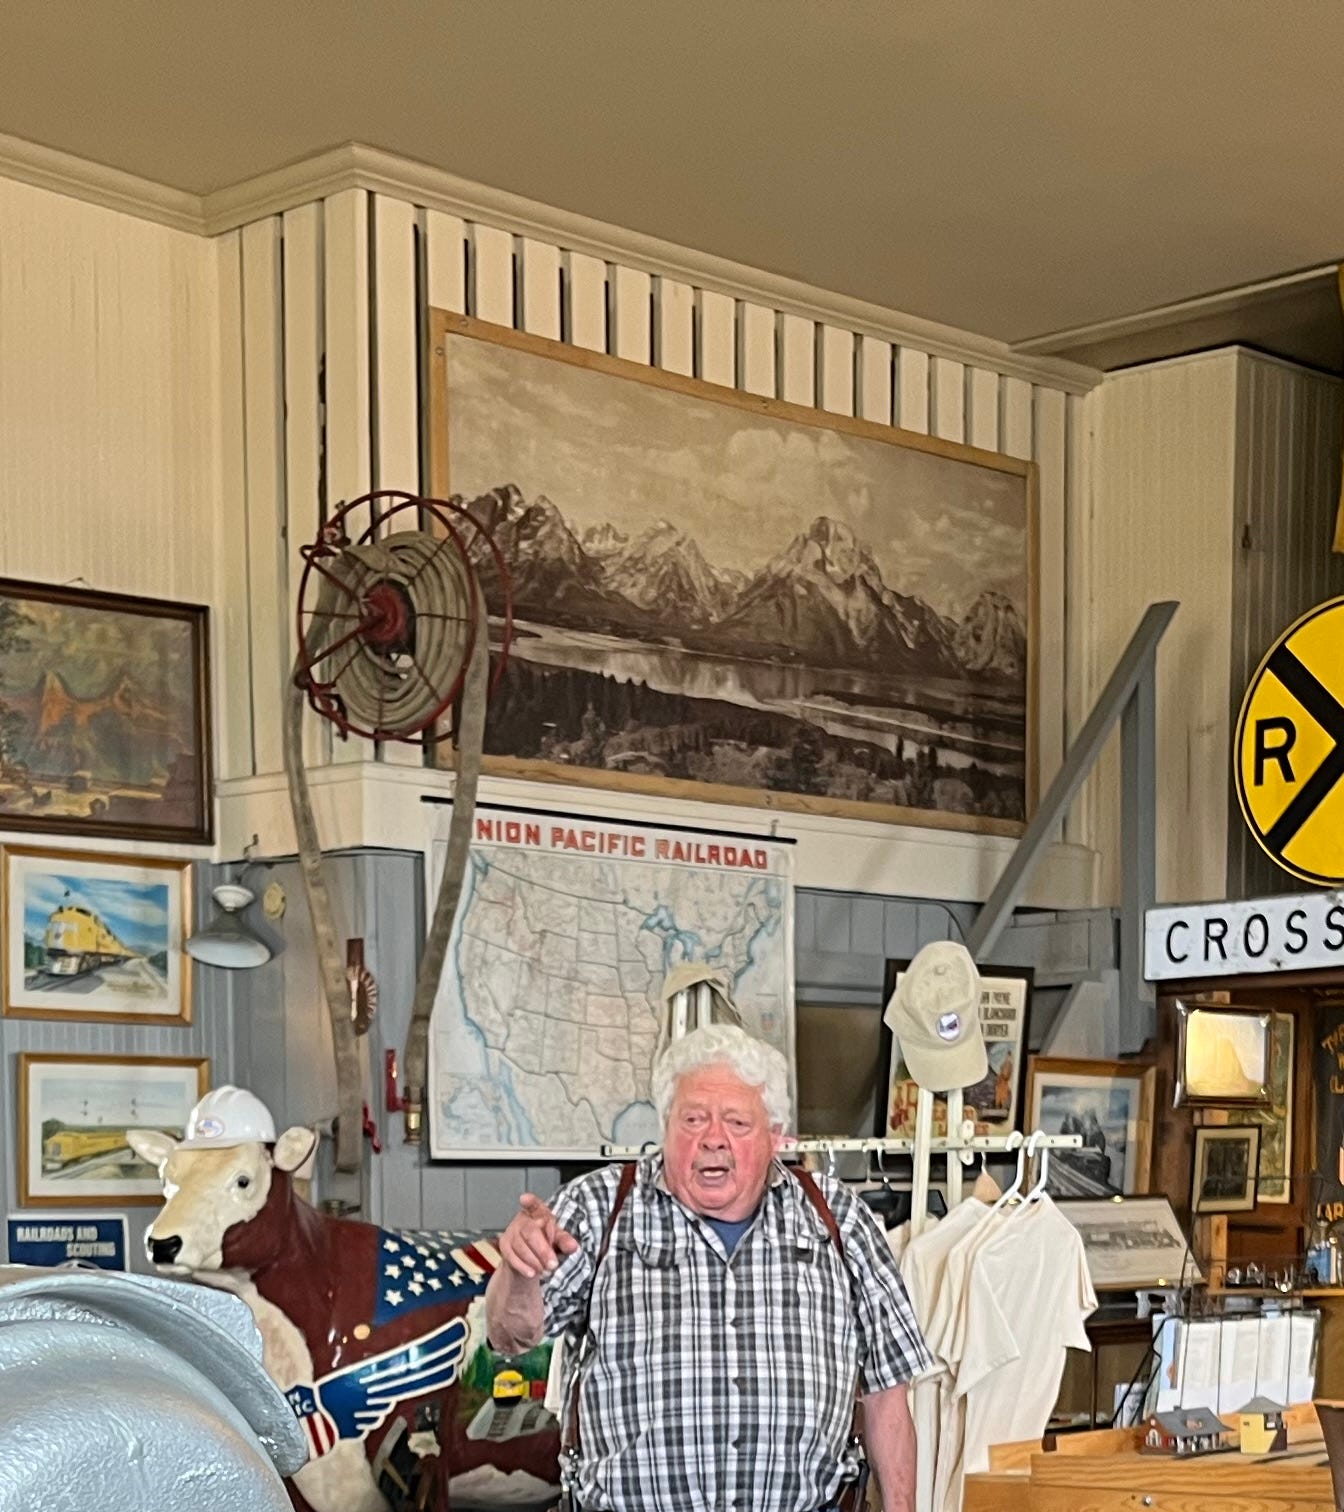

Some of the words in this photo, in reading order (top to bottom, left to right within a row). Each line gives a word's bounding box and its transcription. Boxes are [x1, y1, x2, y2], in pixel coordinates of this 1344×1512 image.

[1254, 724, 1298, 787] R
[476, 817, 541, 847] NION
[550, 826, 646, 858] PACIFIC
[656, 838, 768, 870] RAILROAD
[76, 1226, 98, 1242] AND
